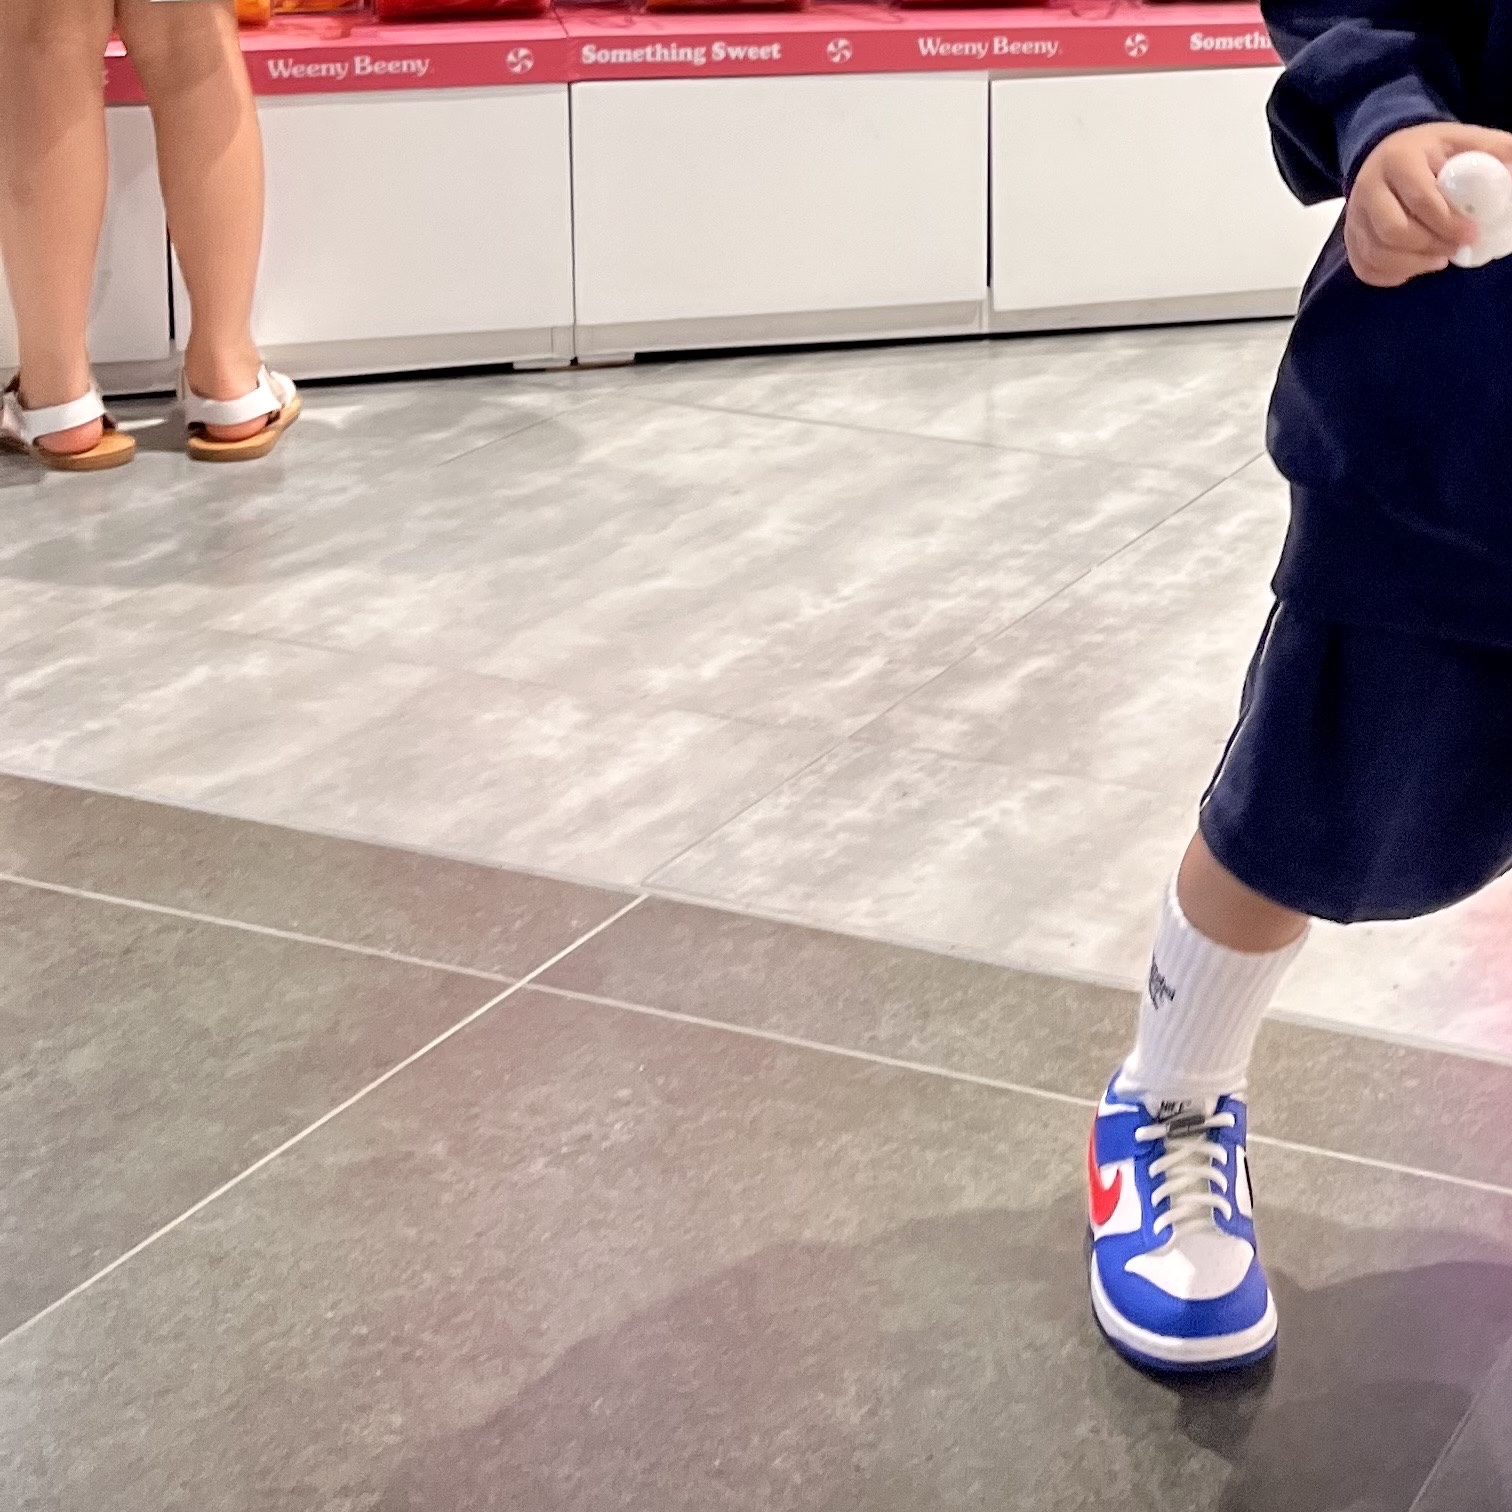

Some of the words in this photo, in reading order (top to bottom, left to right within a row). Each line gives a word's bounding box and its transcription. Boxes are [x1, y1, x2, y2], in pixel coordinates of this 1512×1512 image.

[581, 41, 706, 65] Something
[711, 41, 782, 62] Sweet
[918, 37, 989, 59] Weeny
[992, 36, 1060, 59] Beeny
[267, 57, 349, 80] Weeny
[353, 55, 431, 78] Beeny
